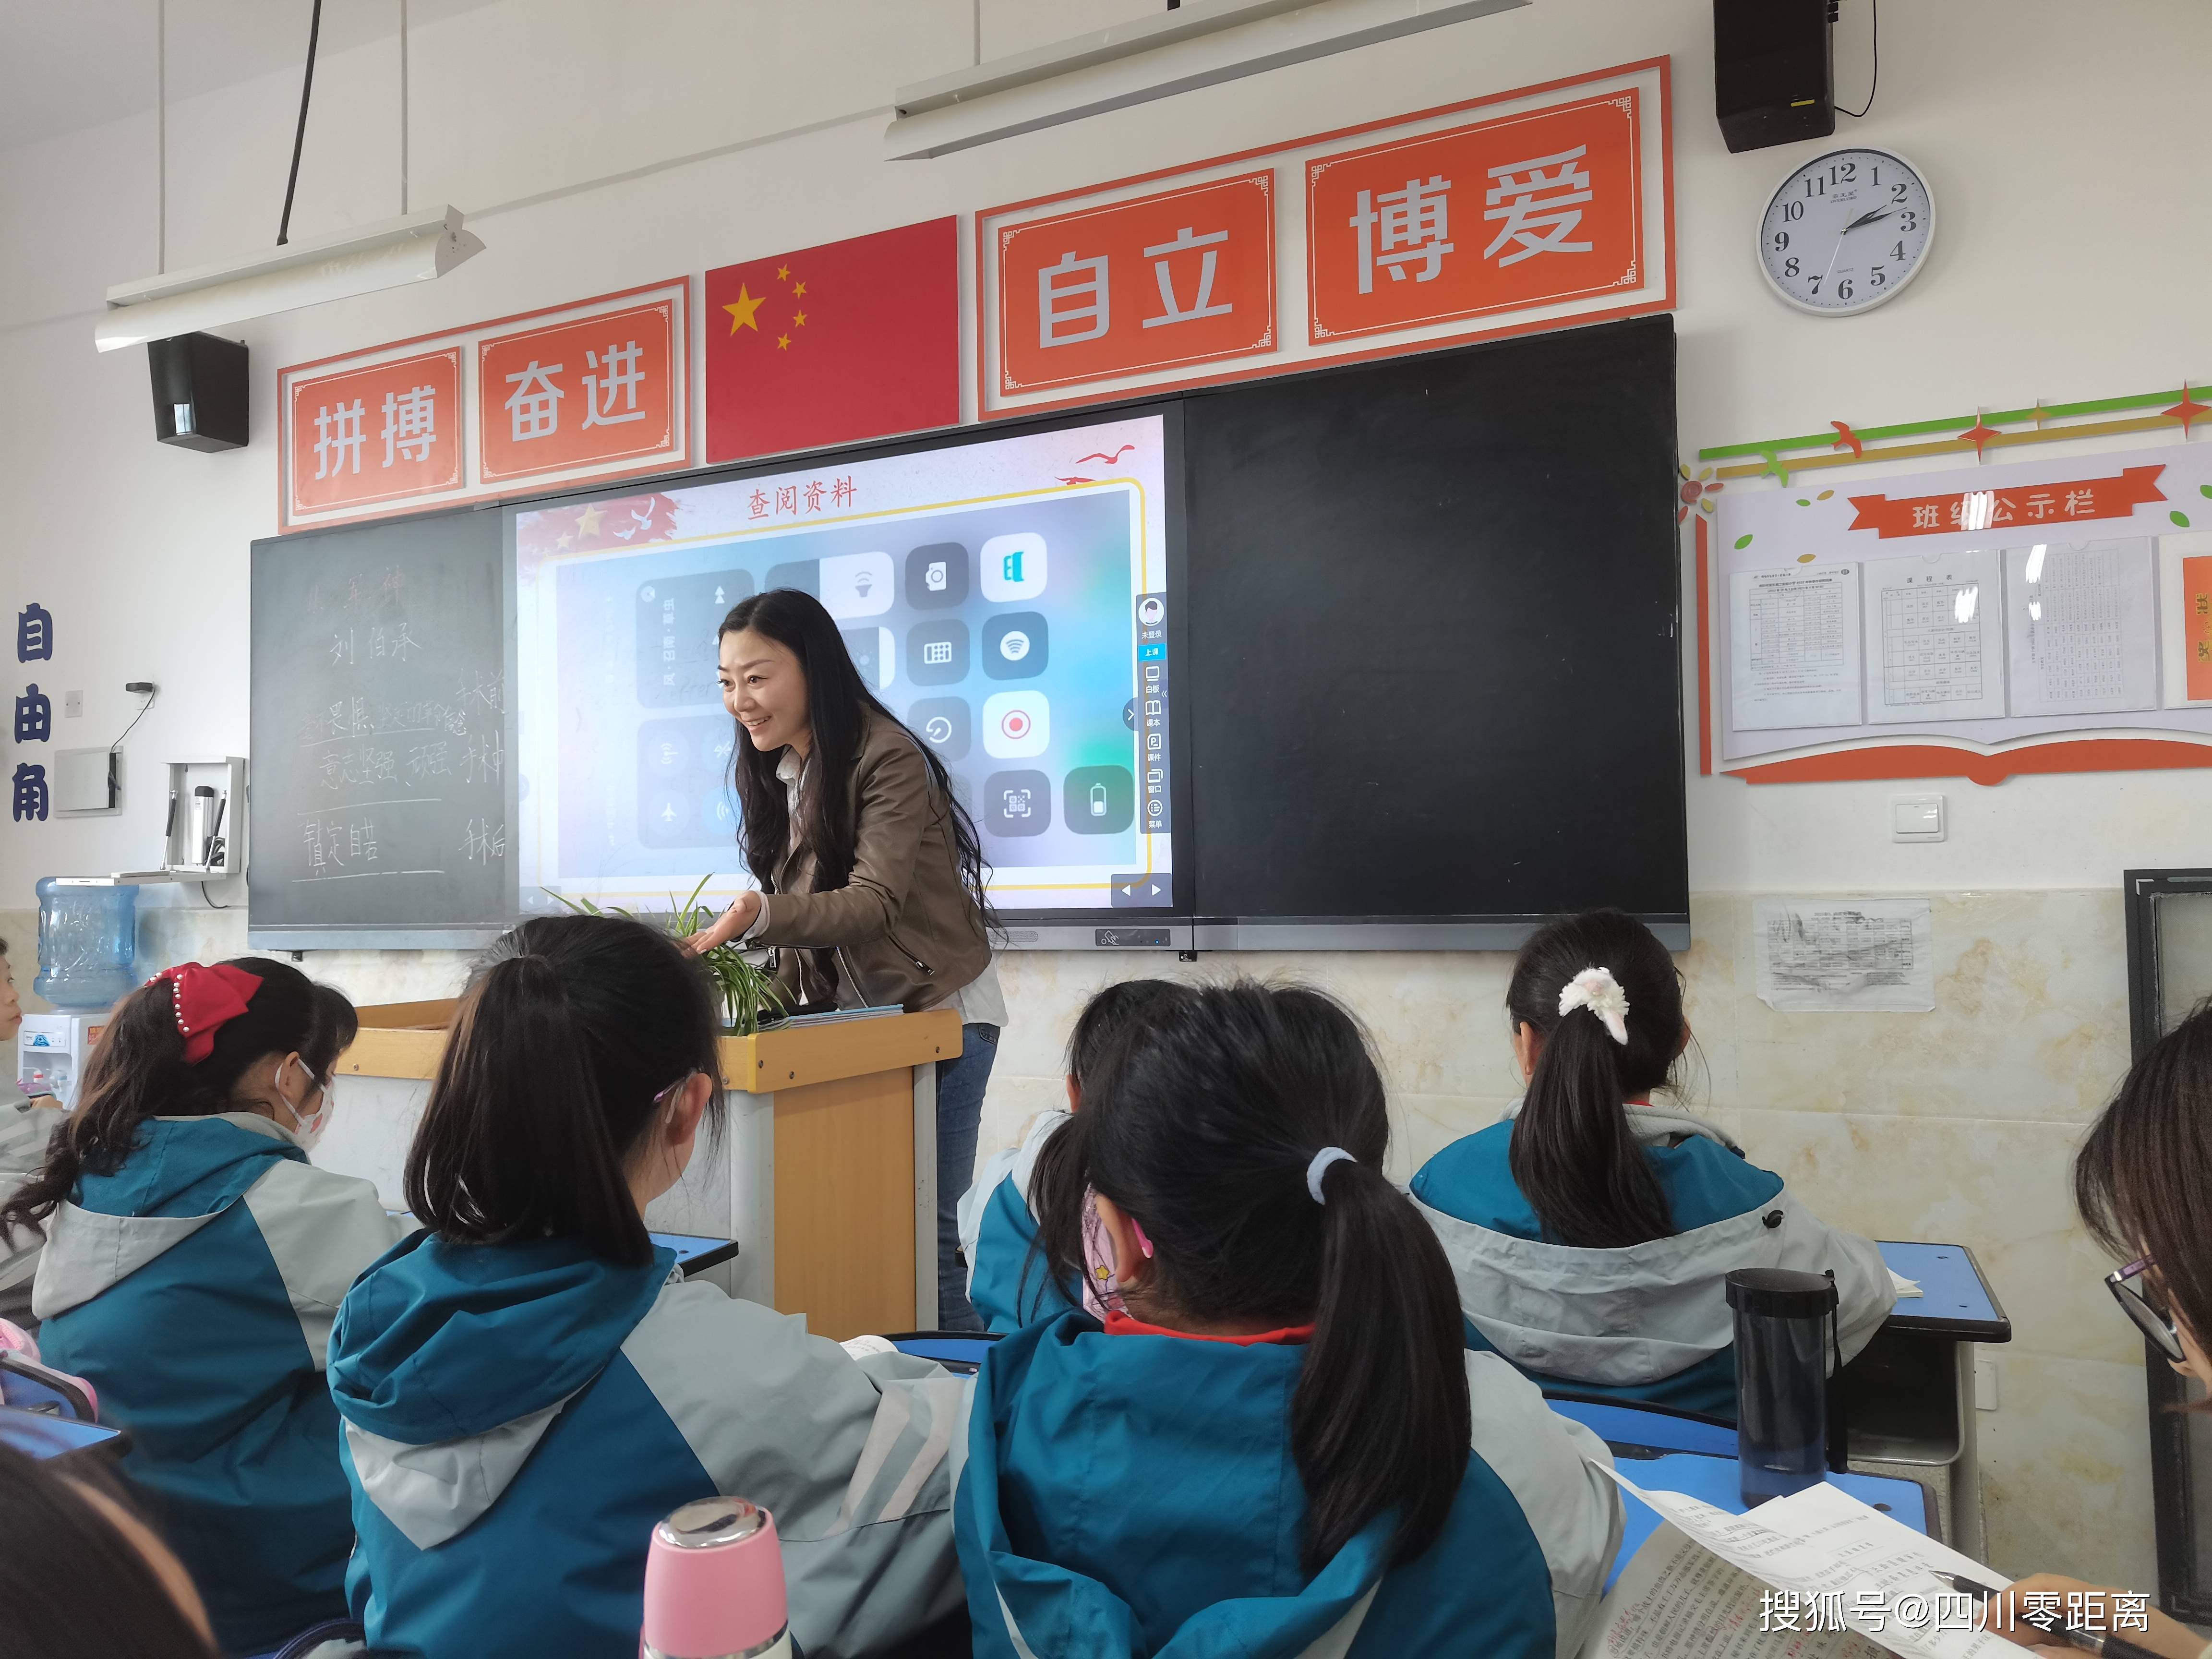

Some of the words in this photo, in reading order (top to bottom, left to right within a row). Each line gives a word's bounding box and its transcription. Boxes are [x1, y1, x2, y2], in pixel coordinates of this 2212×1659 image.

[1829, 163, 1856, 186] 12
[1871, 166, 1881, 186] 1
[1805, 177, 1826, 197] 11
[1891, 184, 1908, 204] 2
[1349, 144, 1594, 294] 博爱
[1783, 201, 1803, 222] 10
[1900, 211, 1916, 231] 3
[1775, 232, 1789, 252] 9
[1890, 240, 1905, 261] 4
[1785, 257, 1799, 277] 8
[1871, 265, 1885, 286] 5
[1038, 227, 1232, 349] 自立
[1808, 275, 1823, 295] 7
[1838, 279, 1852, 299] 6
[504, 340, 646, 443] 奋进
[313, 384, 436, 480] 拼搏
[747, 476, 857, 520] 查阅资料
[330, 623, 422, 666] 刘伯承
[1142, 630, 1162, 639] 未登录
[1145, 648, 1159, 657] 上课
[1146, 685, 1160, 693] 白板
[12, 602, 53, 822] 自由角
[1146, 718, 1161, 727] 课本
[1147, 753, 1161, 762] 课件
[1148, 784, 1162, 793] 窗口
[1148, 820, 1162, 829] 菜单
